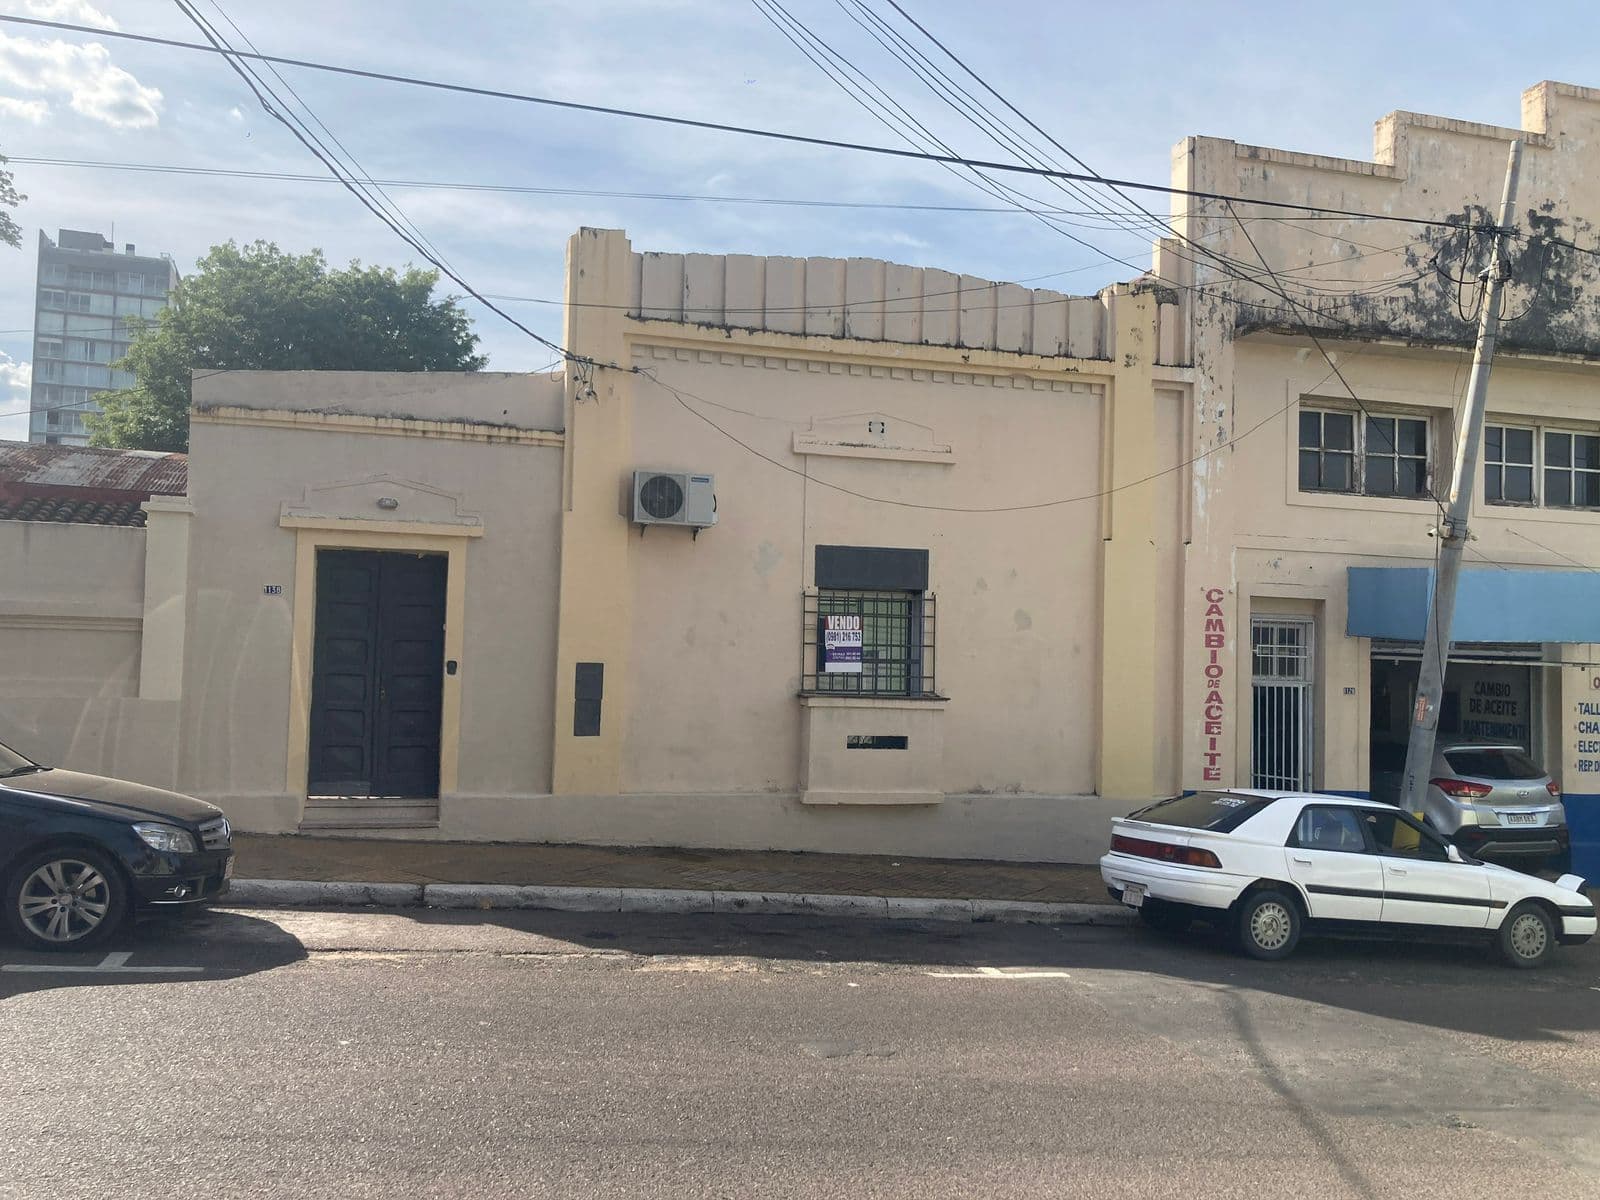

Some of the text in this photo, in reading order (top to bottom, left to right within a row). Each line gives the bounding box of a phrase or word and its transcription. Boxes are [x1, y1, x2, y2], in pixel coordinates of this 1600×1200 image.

[827, 615, 860, 630] VENDO
[1205, 588, 1225, 679] CAMBIO
[1207, 679, 1222, 689] DE
[1474, 681, 1511, 697] CAMBIO
[1469, 698, 1518, 717] DE ACEITE
[1203, 690, 1224, 781] ACEITE
